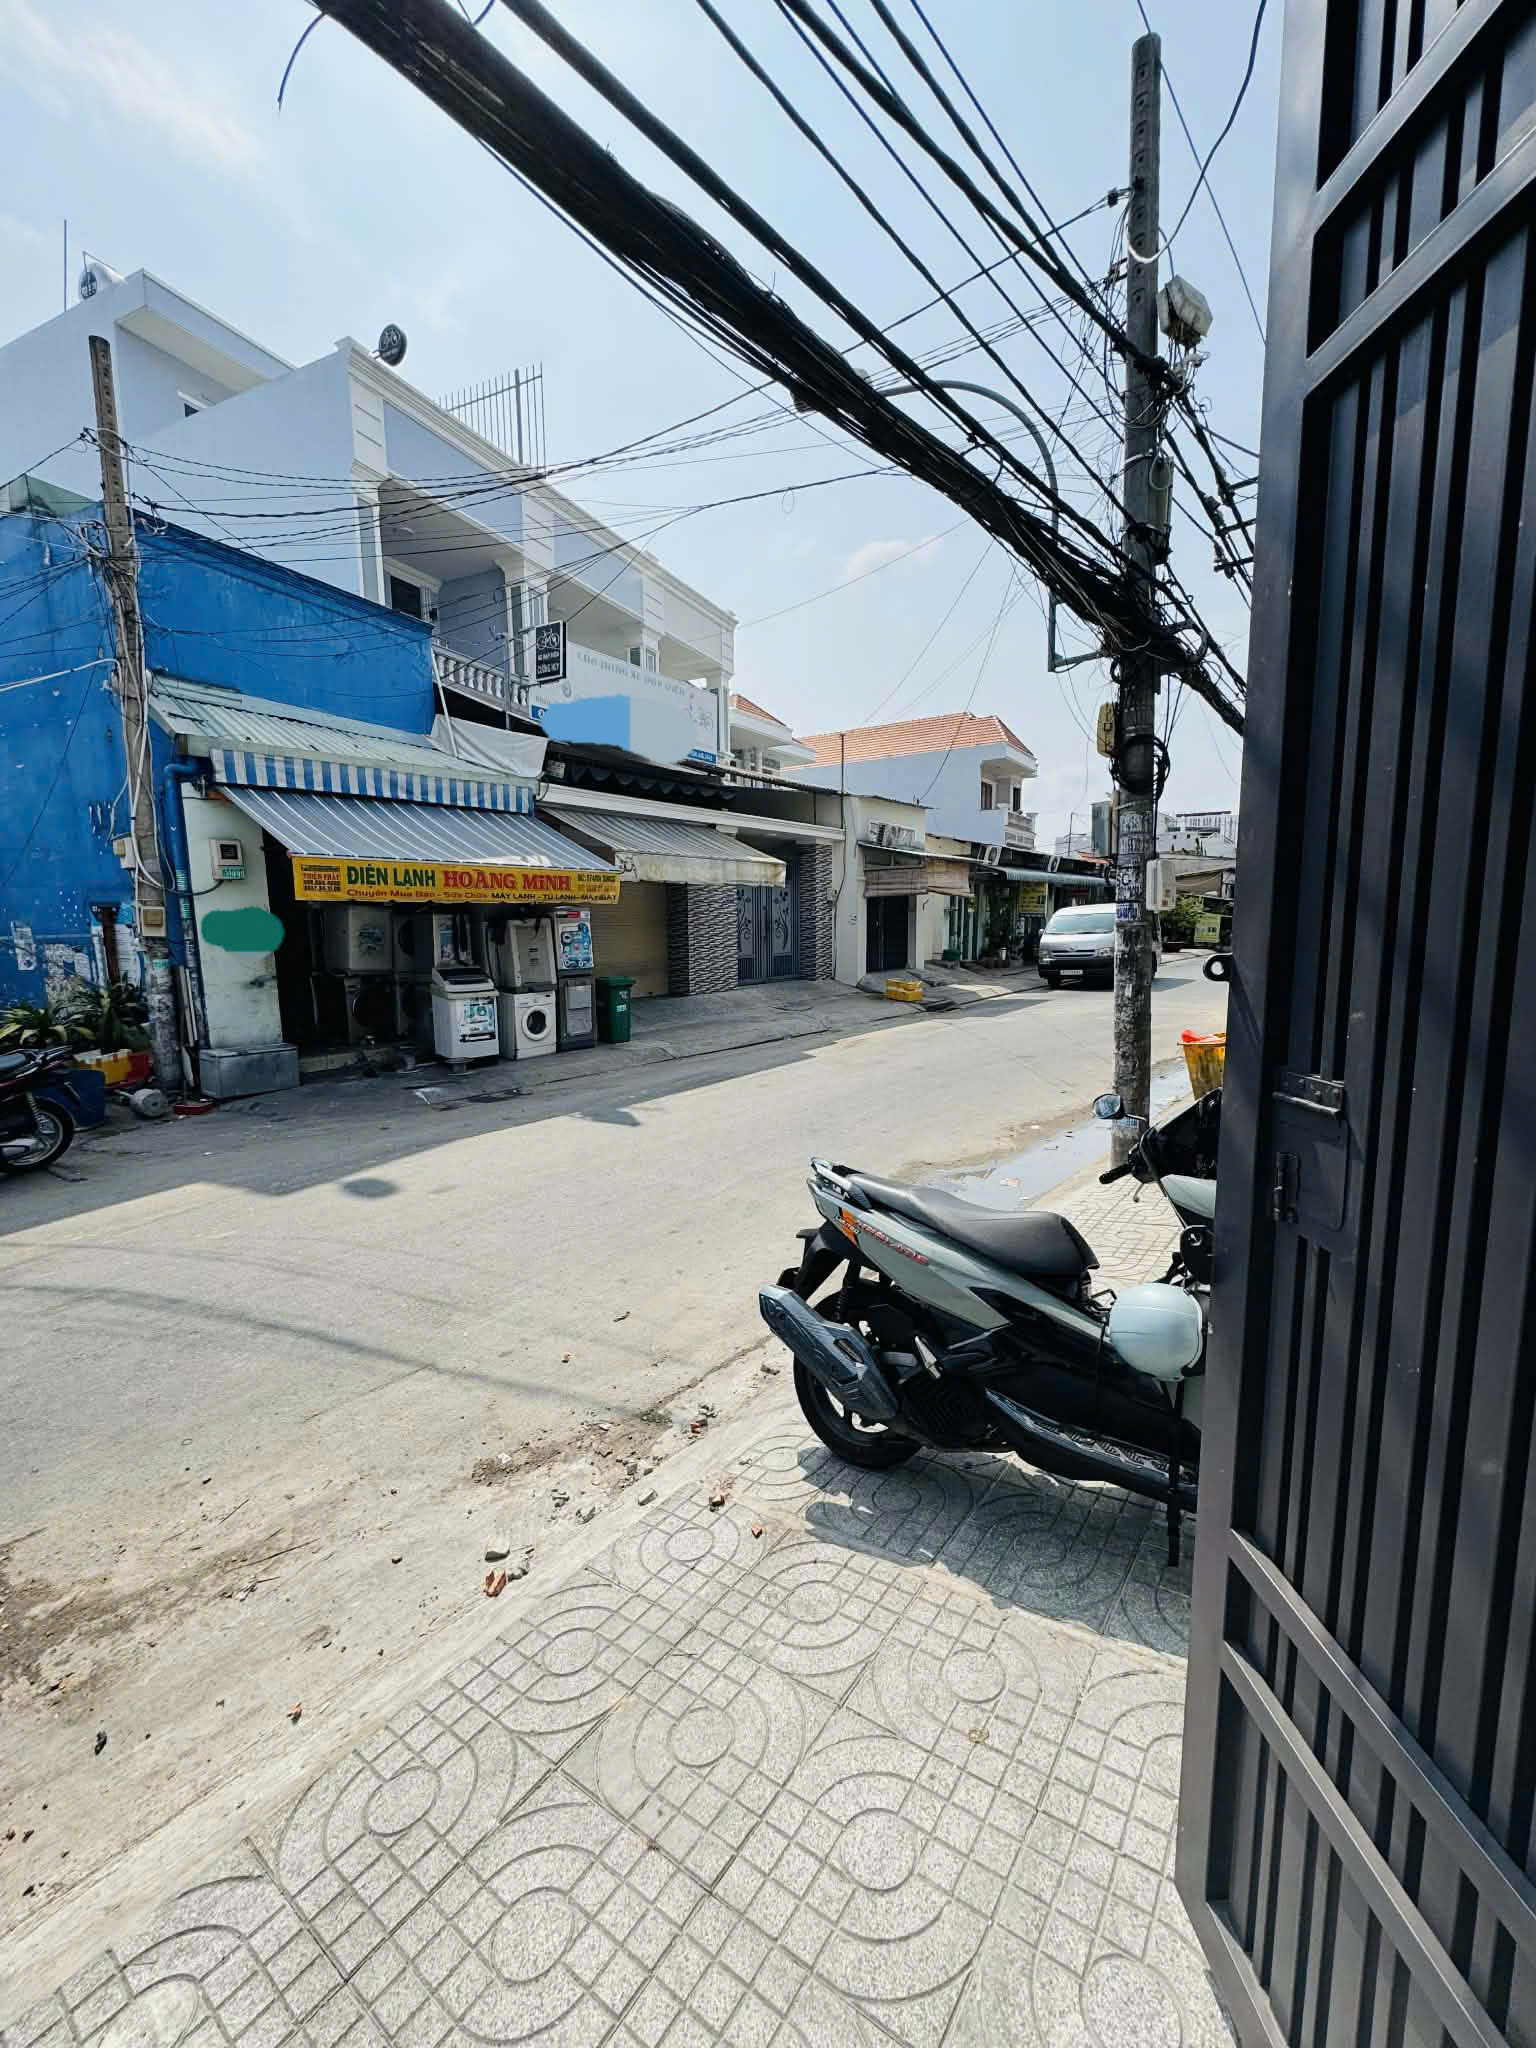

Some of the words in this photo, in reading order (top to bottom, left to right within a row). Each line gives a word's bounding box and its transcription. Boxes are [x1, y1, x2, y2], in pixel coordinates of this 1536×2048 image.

[346, 863, 389, 889] ĐIỆN
[393, 867, 436, 891] LẠNH
[443, 868, 517, 890] HOÀNG
[521, 872, 571, 891] MINH
[346, 888, 387, 898] Chuyên
[390, 889, 413, 898] Mua
